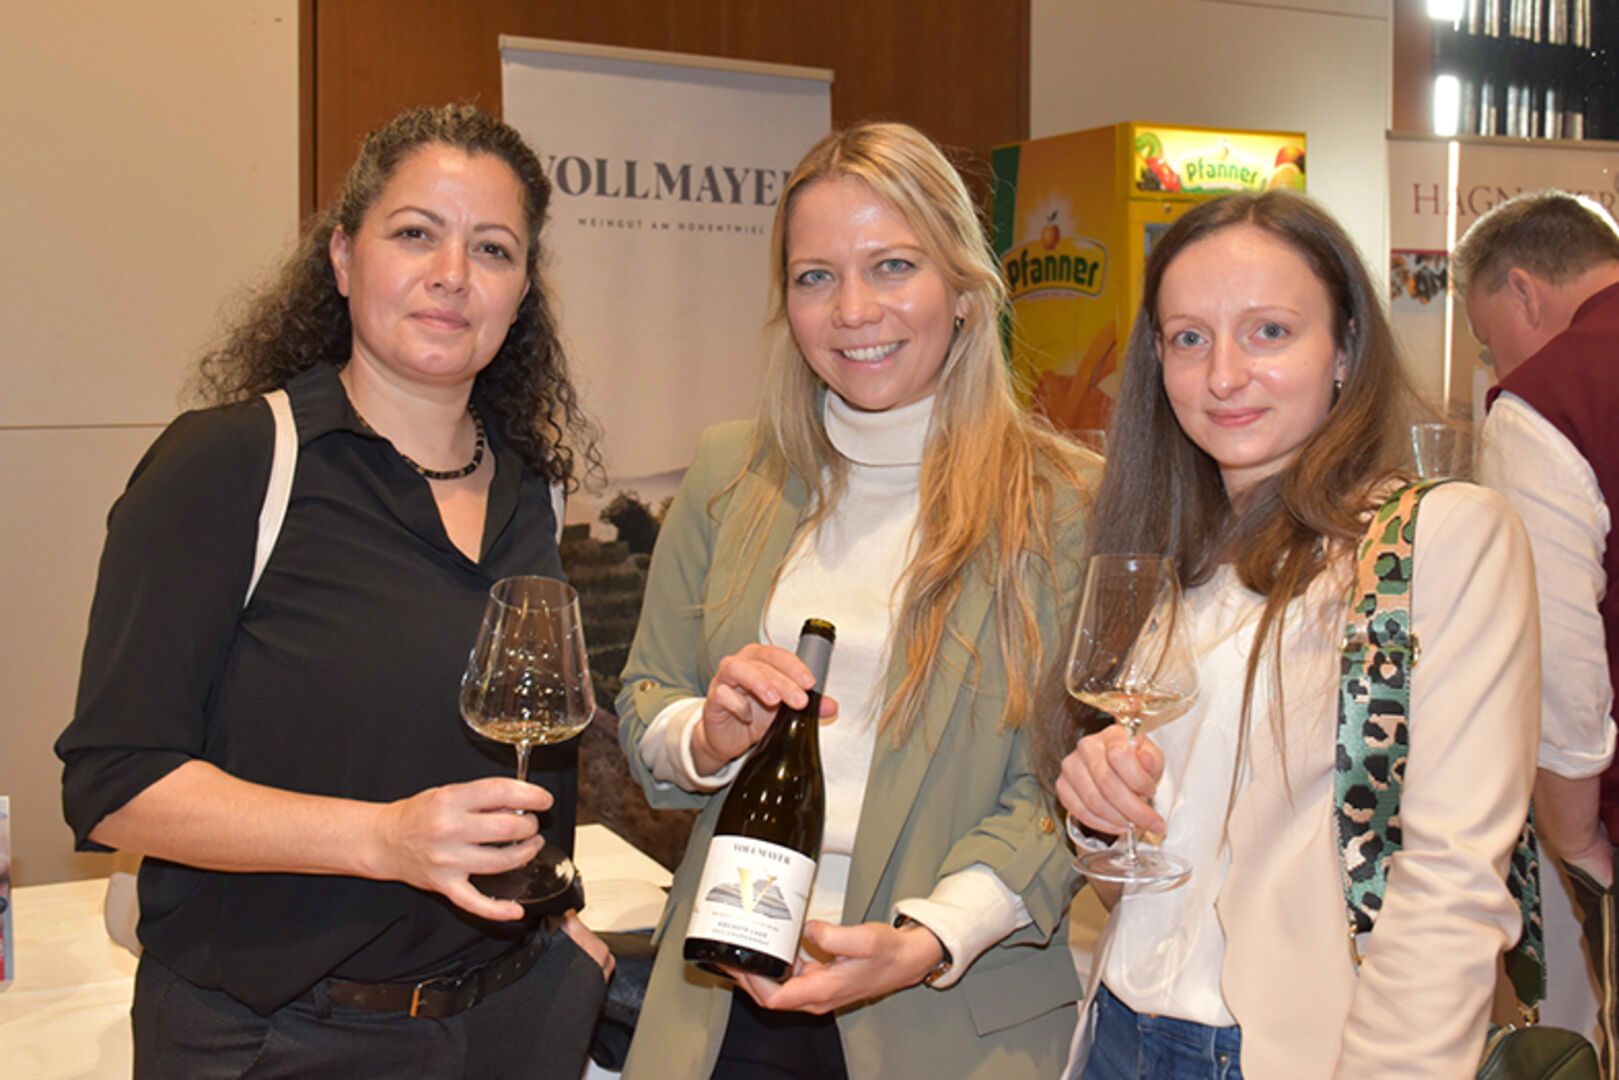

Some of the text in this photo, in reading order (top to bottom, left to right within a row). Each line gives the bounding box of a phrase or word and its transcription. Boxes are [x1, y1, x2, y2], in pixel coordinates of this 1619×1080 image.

[578, 218, 765, 235] WEINGUT AM HOHENTWIEL
